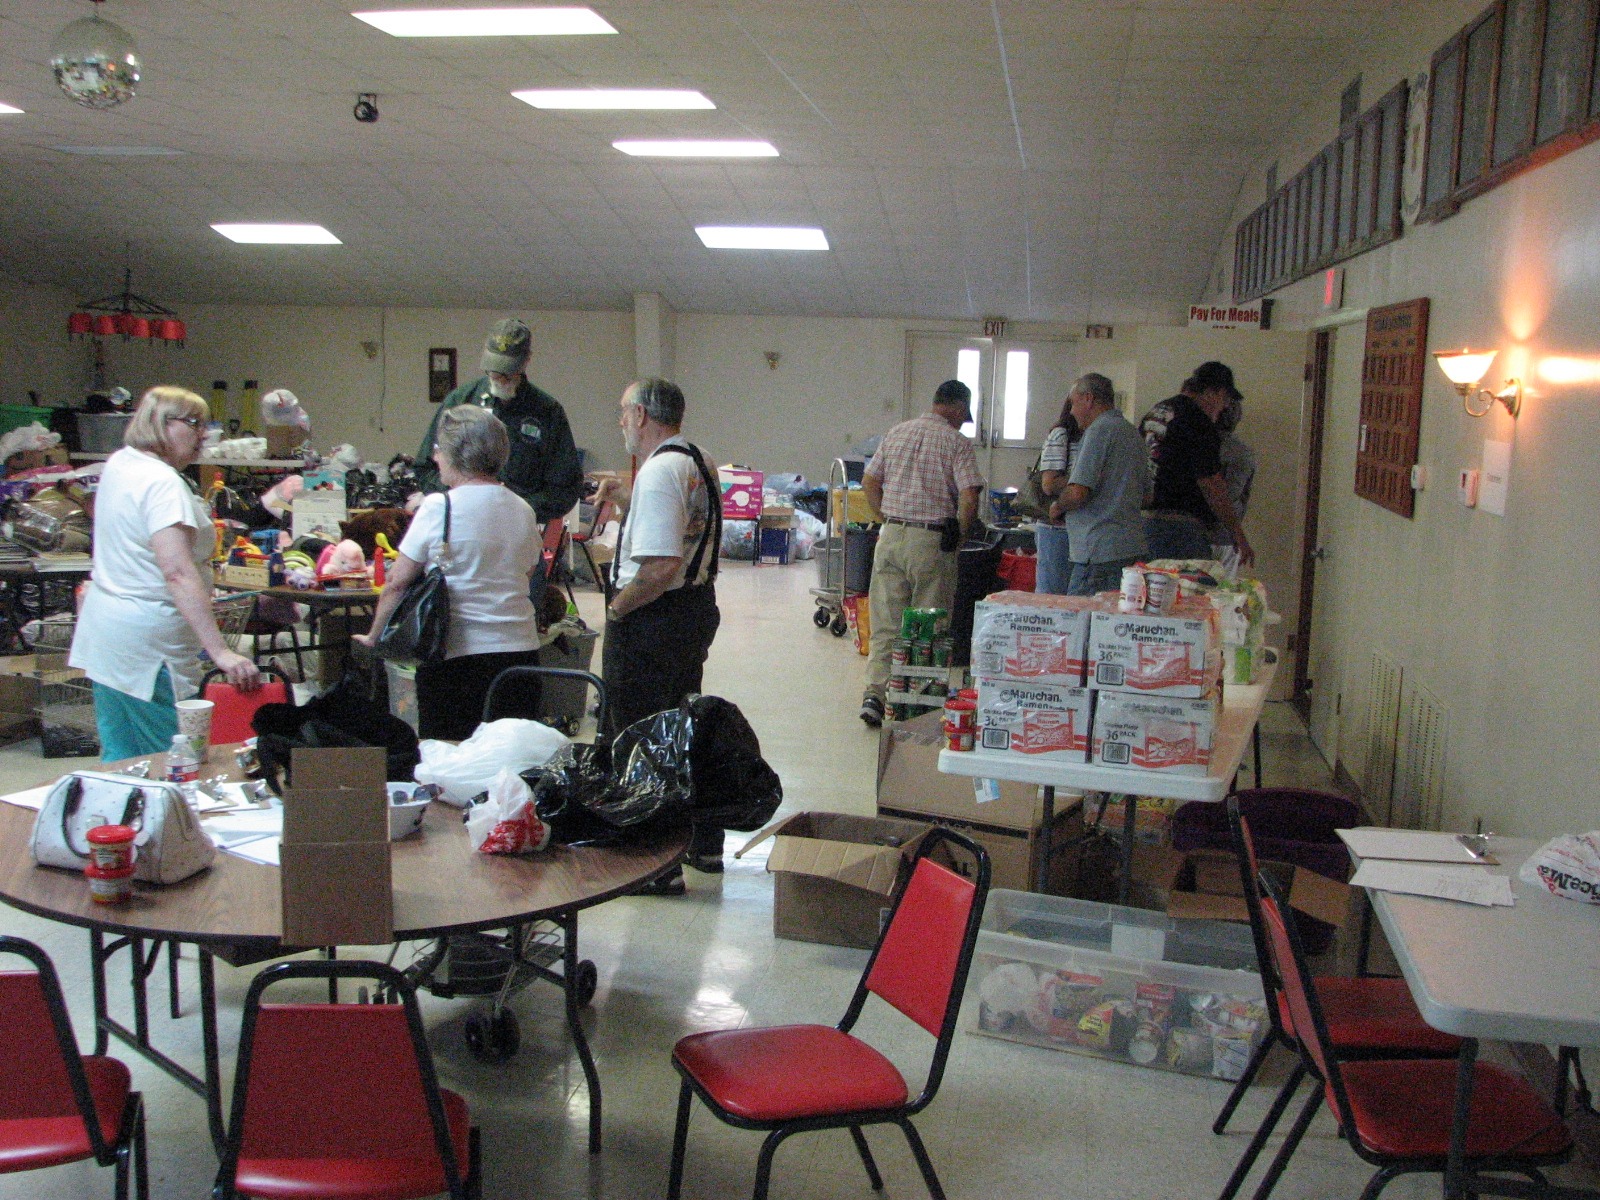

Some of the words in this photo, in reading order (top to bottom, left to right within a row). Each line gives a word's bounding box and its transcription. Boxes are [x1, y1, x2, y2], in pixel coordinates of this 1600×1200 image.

[1190, 306, 1208, 321] Pay
[1210, 307, 1226, 321] For
[1228, 308, 1259, 322] Meals
[984, 320, 1006, 336] EXIT
[1010, 623, 1041, 633] Ramen
[1125, 622, 1177, 636] Maruchan
[1131, 633, 1164, 643] Ramen
[1098, 650, 1113, 662] 36
[1010, 689, 1061, 703] Maruchan
[1017, 700, 1048, 709] Ramen
[1105, 729, 1119, 741] 36
[1119, 730, 1137, 739] PACK
